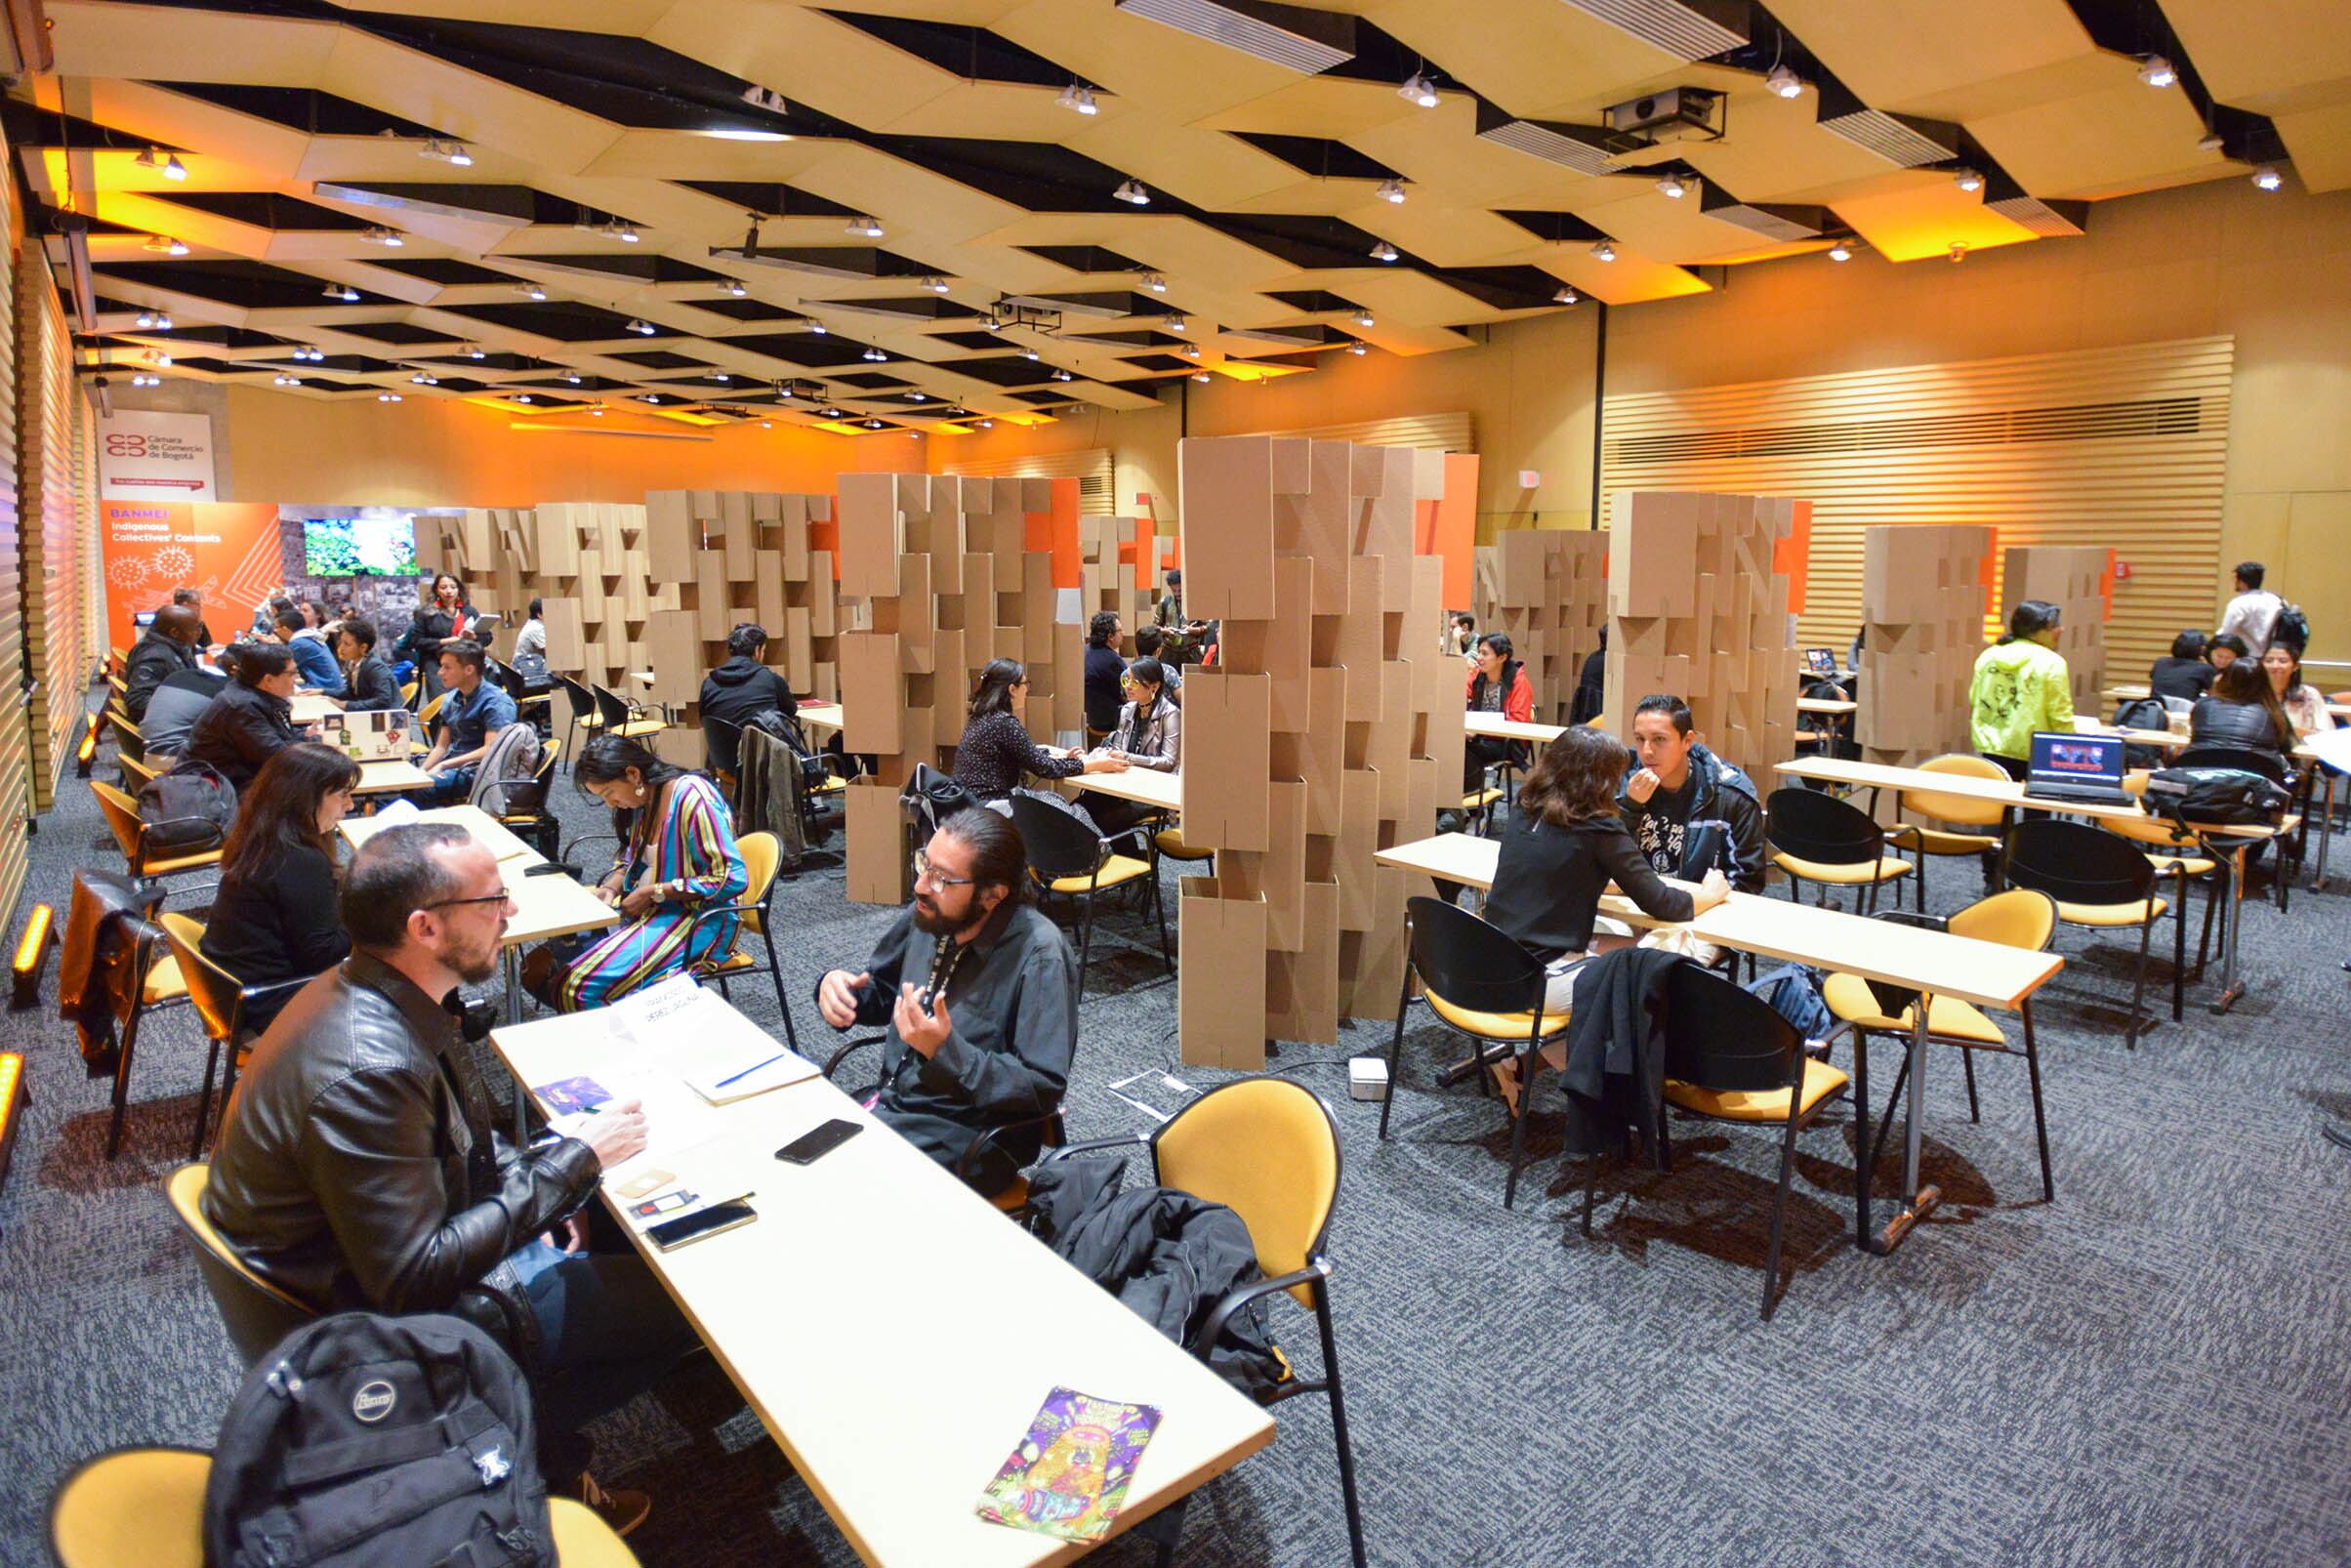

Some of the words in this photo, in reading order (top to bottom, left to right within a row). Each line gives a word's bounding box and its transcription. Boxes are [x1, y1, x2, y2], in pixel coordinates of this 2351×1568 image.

[161, 444, 204, 453] Comercio
[162, 451, 194, 461] Bogotá
[109, 509, 169, 518] BANMEI
[111, 522, 170, 532] Indigenous
[174, 533, 223, 543] Contents
